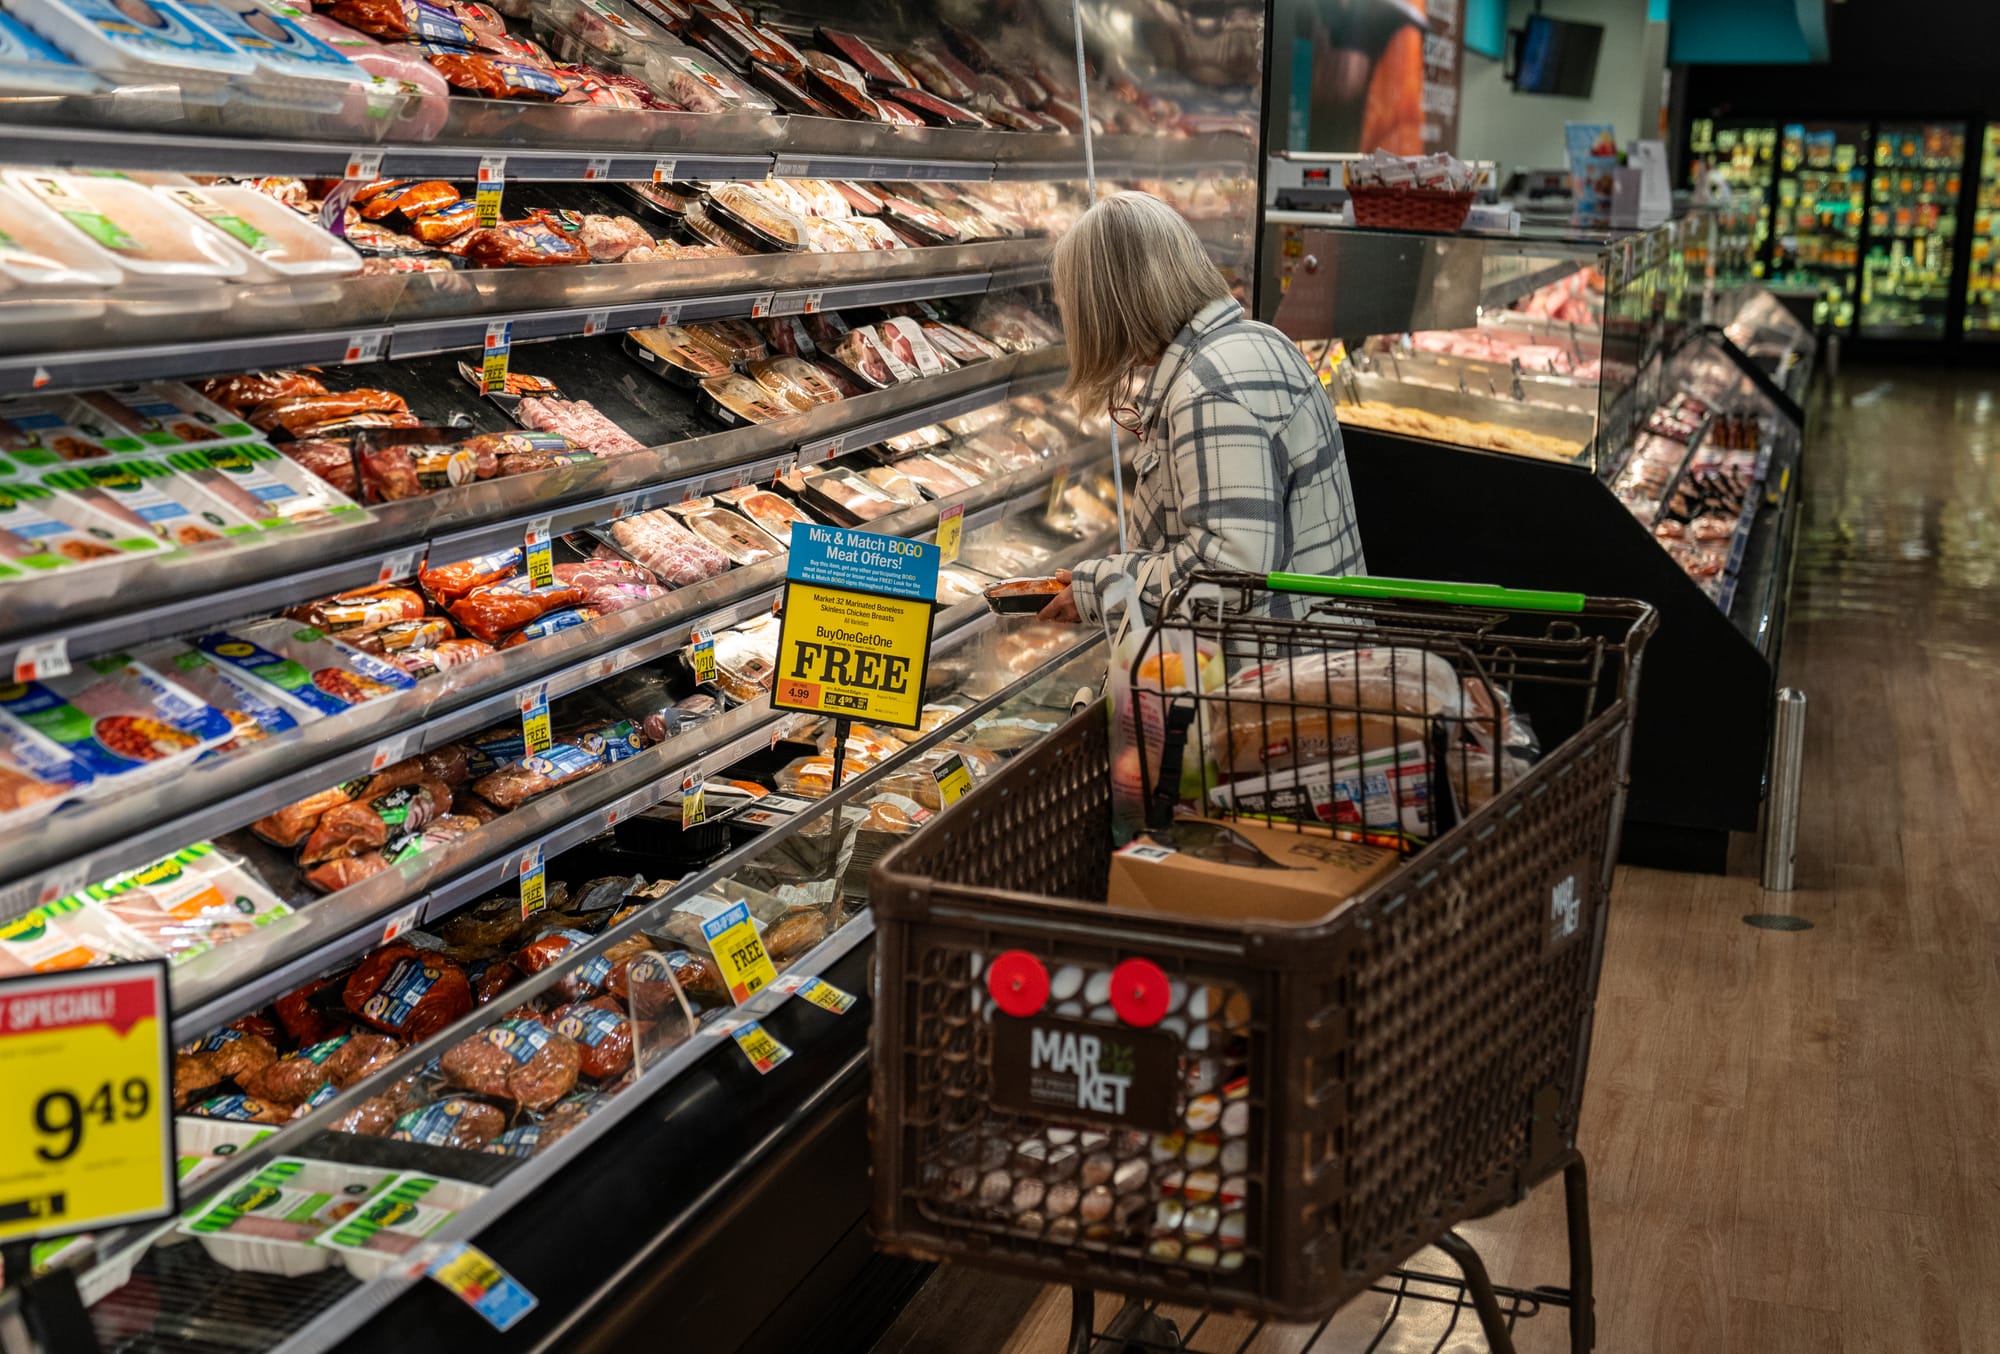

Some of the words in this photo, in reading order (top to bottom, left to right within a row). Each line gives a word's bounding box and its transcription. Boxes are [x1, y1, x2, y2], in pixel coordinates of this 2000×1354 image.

[476, 204, 497, 217] FREE
[484, 368, 503, 381] FREE
[810, 528, 831, 543] Mix
[834, 532, 844, 545] &
[847, 534, 885, 552] Match
[888, 540, 922, 558] BOGO
[827, 546, 857, 563] Meat
[861, 551, 902, 570] Offers!
[530, 563, 549, 578] FREE
[816, 566, 827, 574] item
[833, 568, 846, 577] equal
[852, 572, 866, 580] lesser
[866, 574, 878, 582] value
[880, 576, 892, 584] FREE!
[859, 566, 872, 574] other
[872, 568, 901, 578] participating
[816, 574, 830, 582] Match
[831, 576, 845, 584] BOGO
[846, 578, 858, 587] signs
[858, 580, 883, 590] throughout
[884, 584, 892, 592] the
[814, 594, 835, 605] Market
[836, 597, 844, 605] 32
[846, 599, 876, 610] Marinated
[877, 604, 904, 615] Boneless
[820, 604, 846, 616] Skinless
[846, 608, 870, 618] Chicken
[872, 612, 894, 622] Breasts
[850, 618, 869, 627] Varieties
[791, 640, 910, 694] FREE
[788, 688, 810, 698] 4.99
[527, 727, 547, 745] FREE
[522, 886, 542, 904] FREE
[730, 940, 764, 972] FREE
[9, 988, 116, 1030] SPECIAL!
[1031, 1027, 1100, 1075] MAR
[1078, 1069, 1133, 1116] KET
